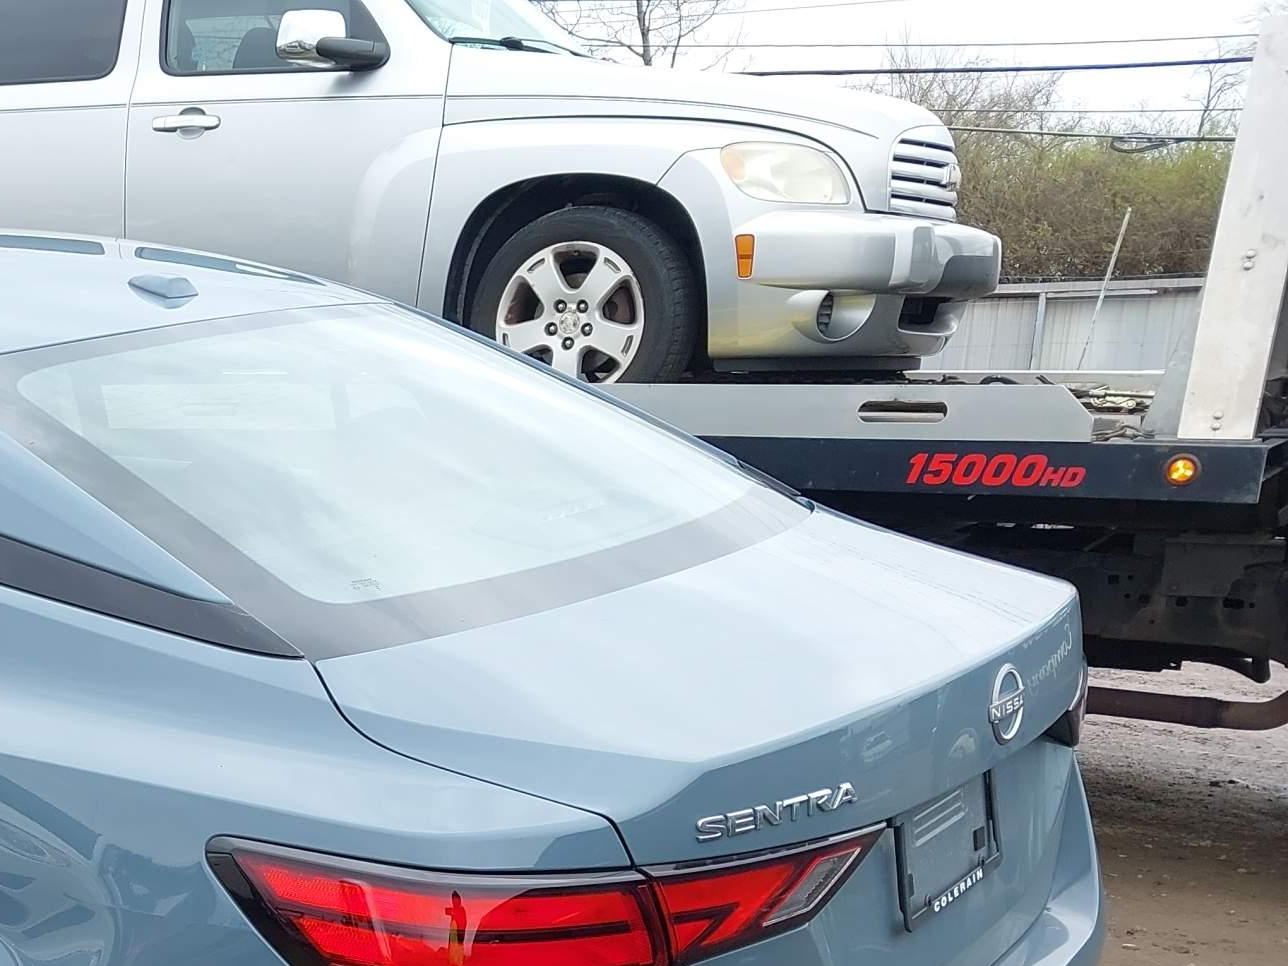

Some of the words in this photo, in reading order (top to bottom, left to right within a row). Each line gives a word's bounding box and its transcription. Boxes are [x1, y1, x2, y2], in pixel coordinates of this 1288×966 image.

[906, 453, 1087, 488] 15000HD
[696, 782, 858, 843] SENTRA
[933, 868, 983, 913] COLERAIN
